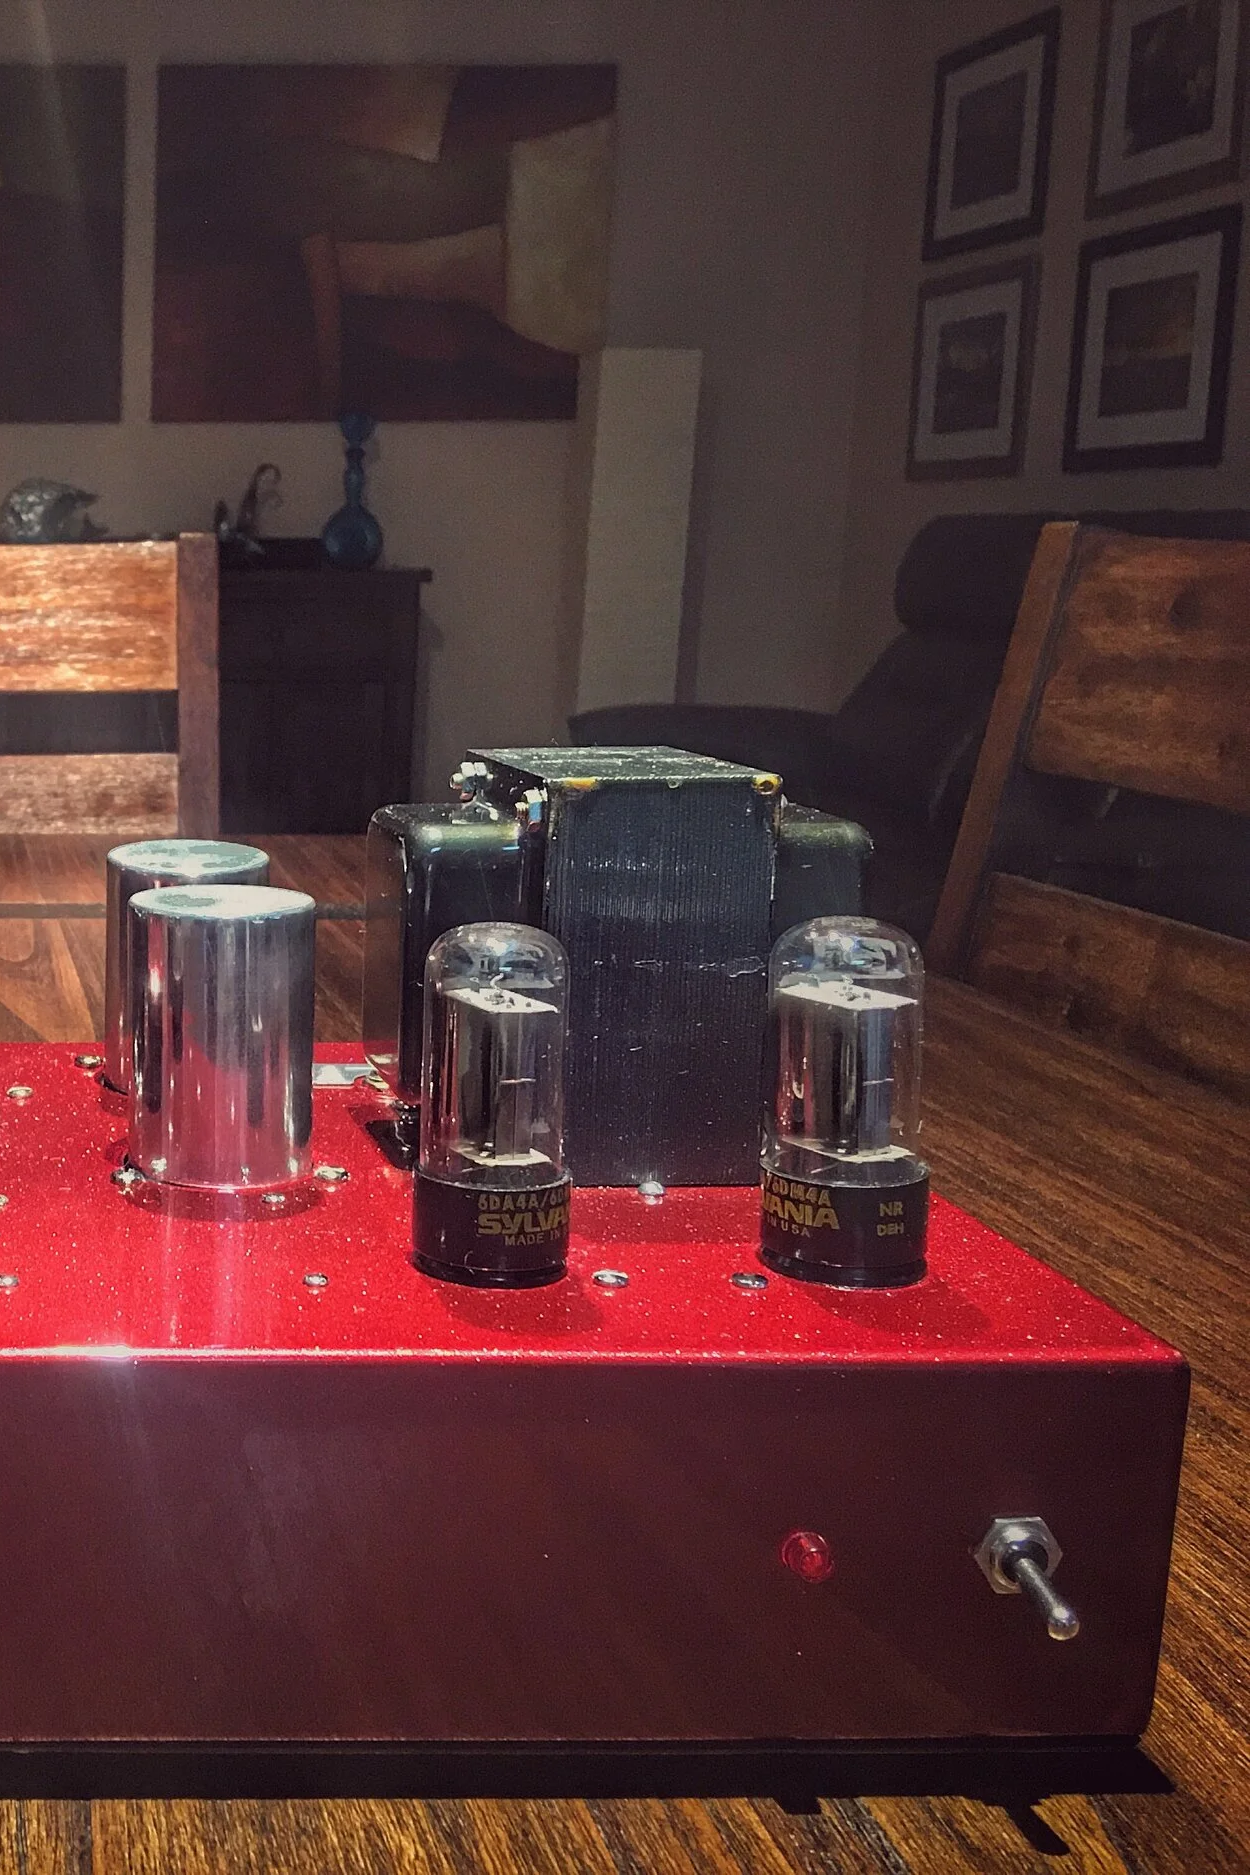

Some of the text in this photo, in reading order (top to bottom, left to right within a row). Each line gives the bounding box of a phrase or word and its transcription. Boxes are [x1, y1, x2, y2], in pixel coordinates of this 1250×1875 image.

[879, 1201, 904, 1217] NR
[781, 1221, 811, 1238] USA
[505, 1232, 545, 1247] MADE
